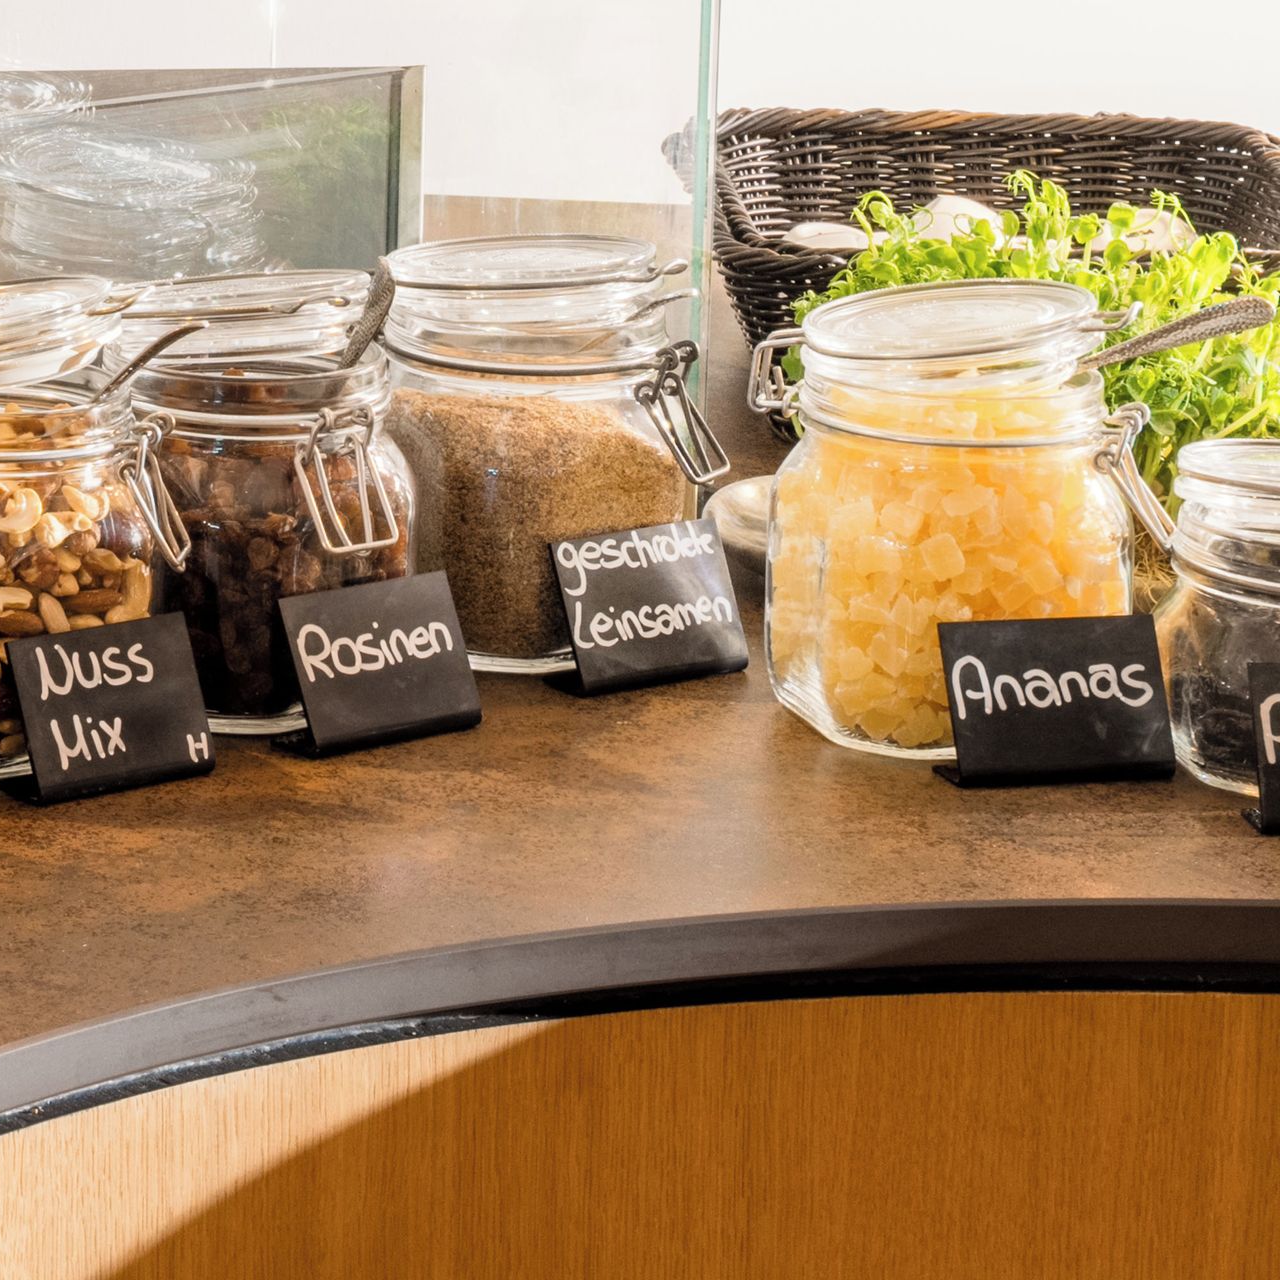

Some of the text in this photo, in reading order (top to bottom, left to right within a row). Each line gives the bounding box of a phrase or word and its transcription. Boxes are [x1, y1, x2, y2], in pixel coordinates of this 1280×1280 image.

[574, 595, 732, 648] Leinsamen
[35, 643, 154, 700] Nuss
[297, 621, 453, 683] Rosinen
[952, 655, 1153, 720] Ananas
[50, 714, 126, 770] Mix
[186, 732, 208, 763] H
